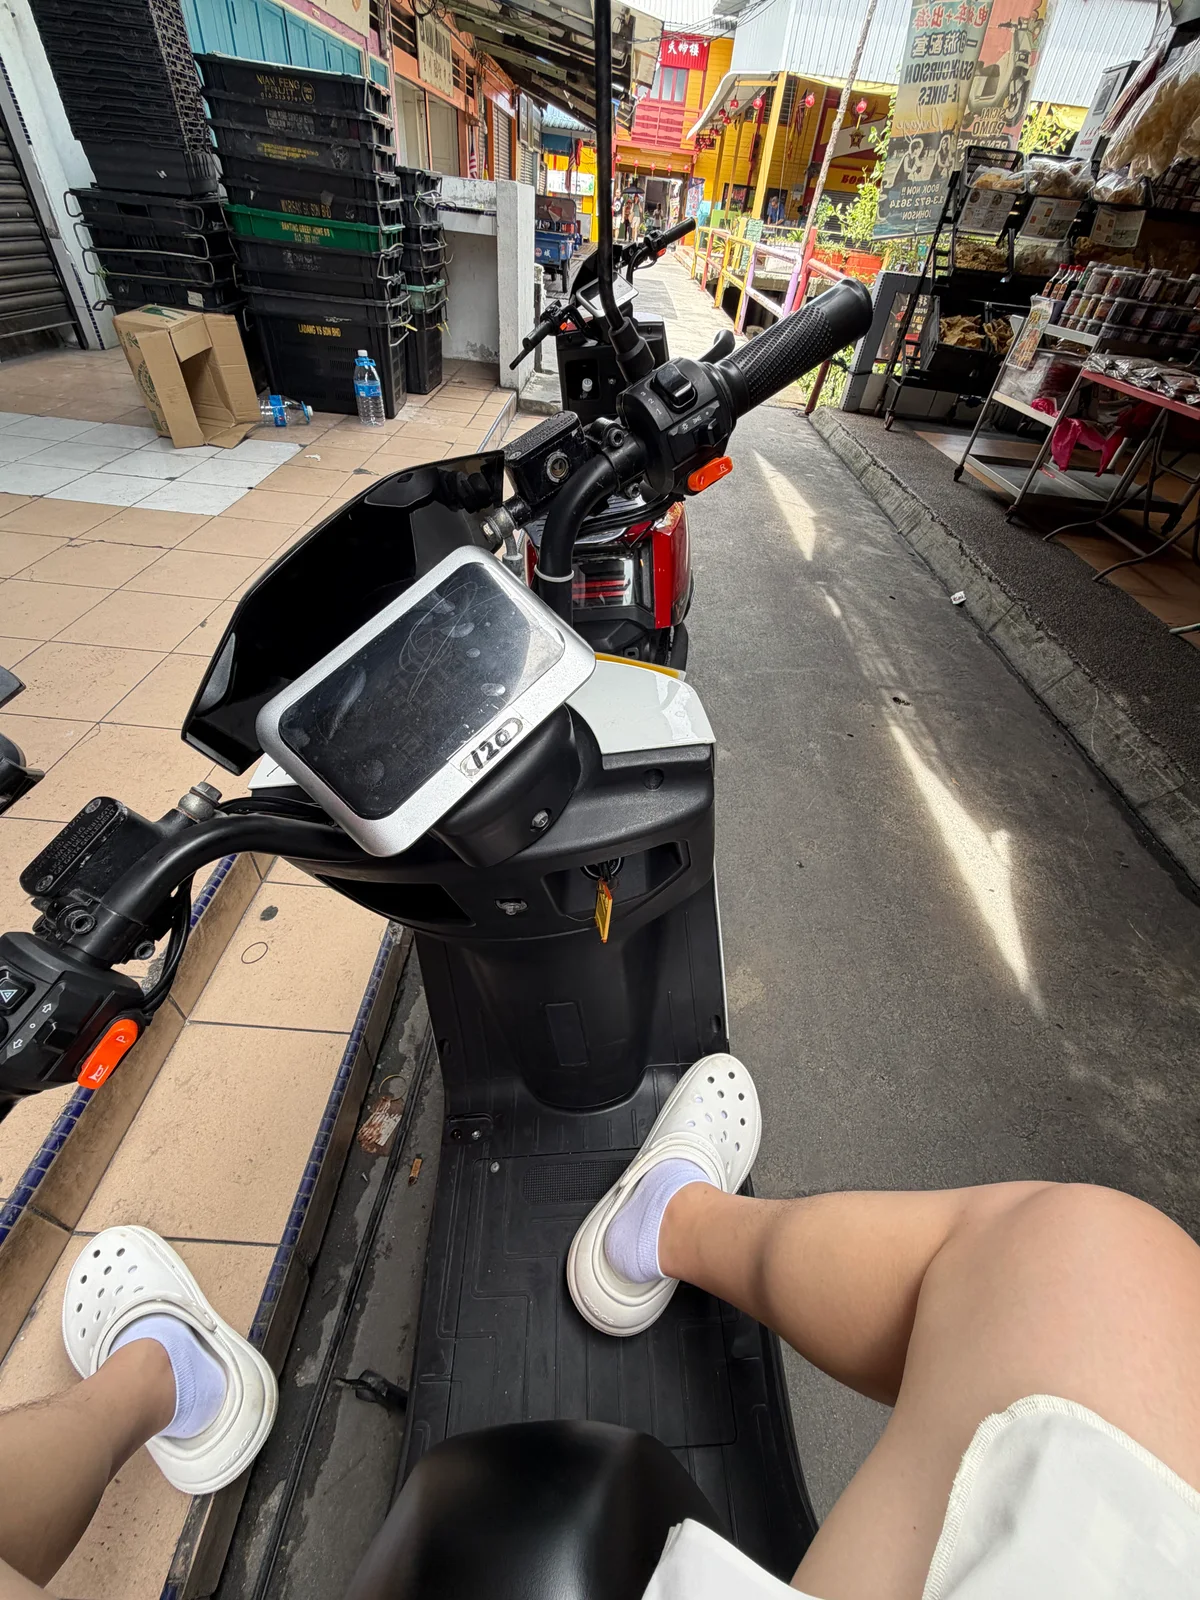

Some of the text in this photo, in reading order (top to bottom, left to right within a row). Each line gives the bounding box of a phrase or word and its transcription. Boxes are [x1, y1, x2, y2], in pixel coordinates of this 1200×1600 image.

[279, 78, 300, 90] FENG
[719, 463, 727, 472] R
[51, 824, 86, 861] WARNING
[584, 1295, 614, 1325] crocs
[218, 1430, 253, 1472] crocs
